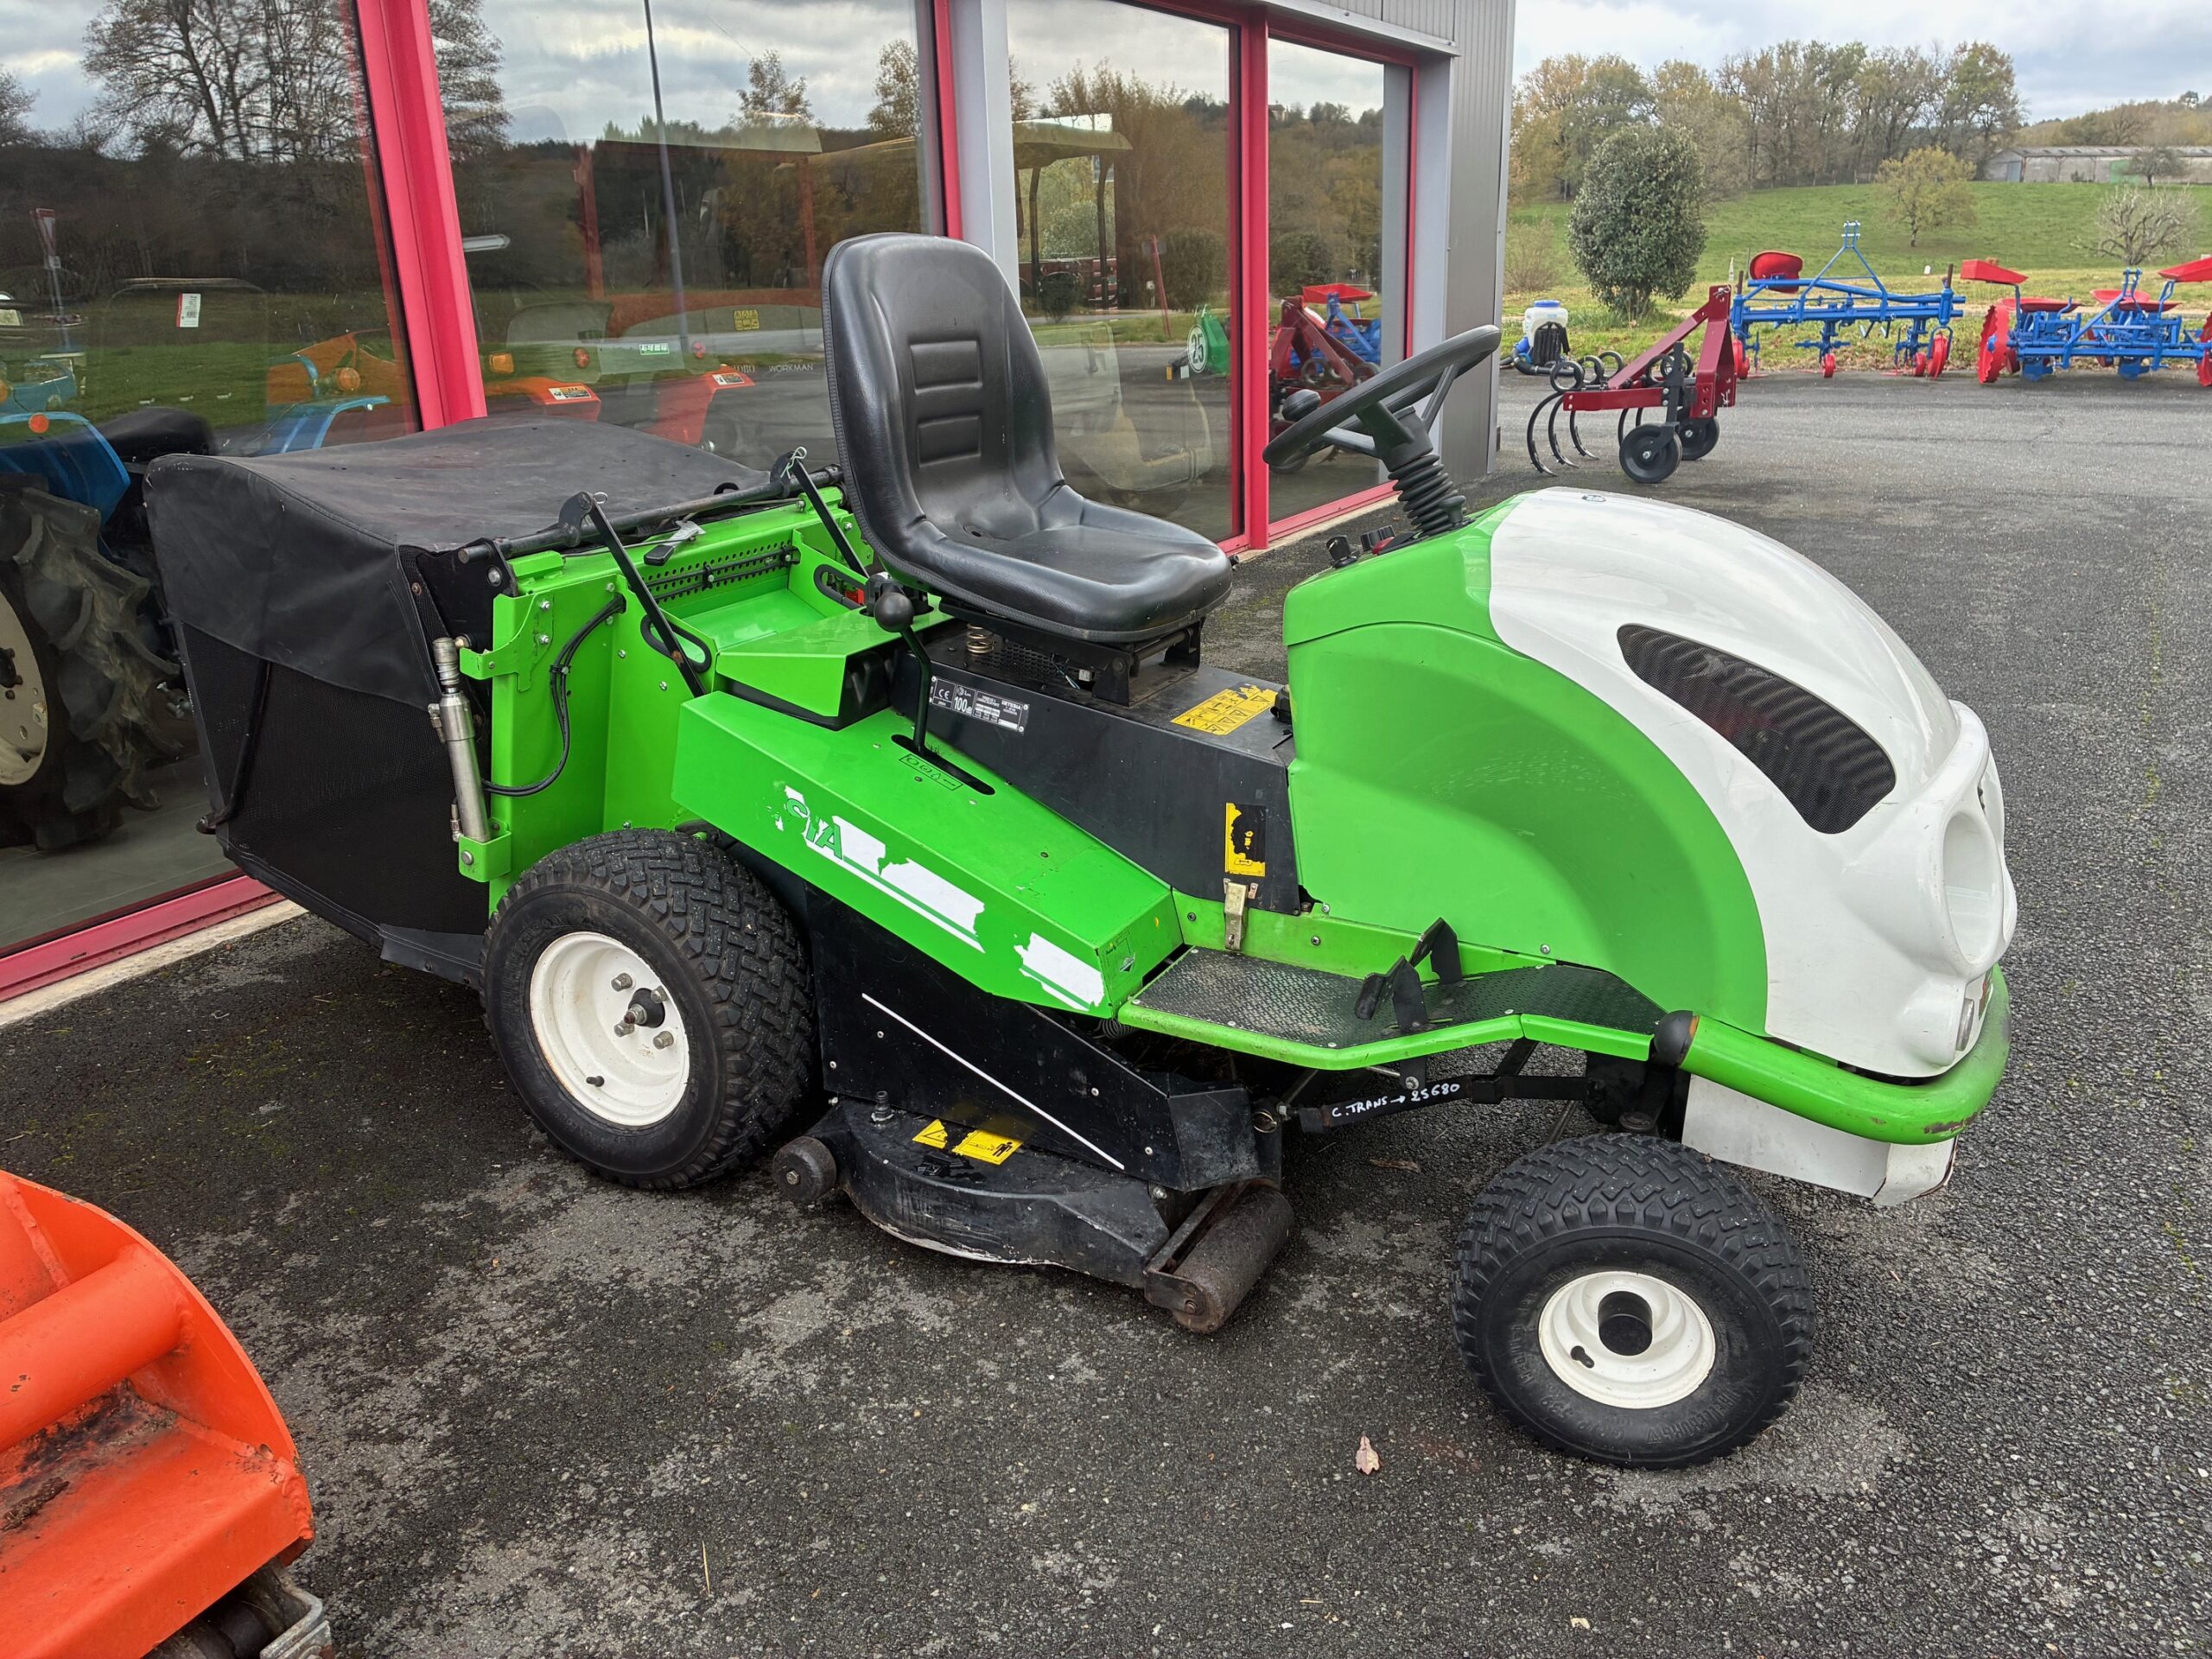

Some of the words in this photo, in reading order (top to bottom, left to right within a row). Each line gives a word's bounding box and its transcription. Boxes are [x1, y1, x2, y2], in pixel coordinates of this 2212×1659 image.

[1192, 334, 1204, 364] 25
[769, 363, 814, 373] WORKMAN
[954, 696, 968, 713] 100
